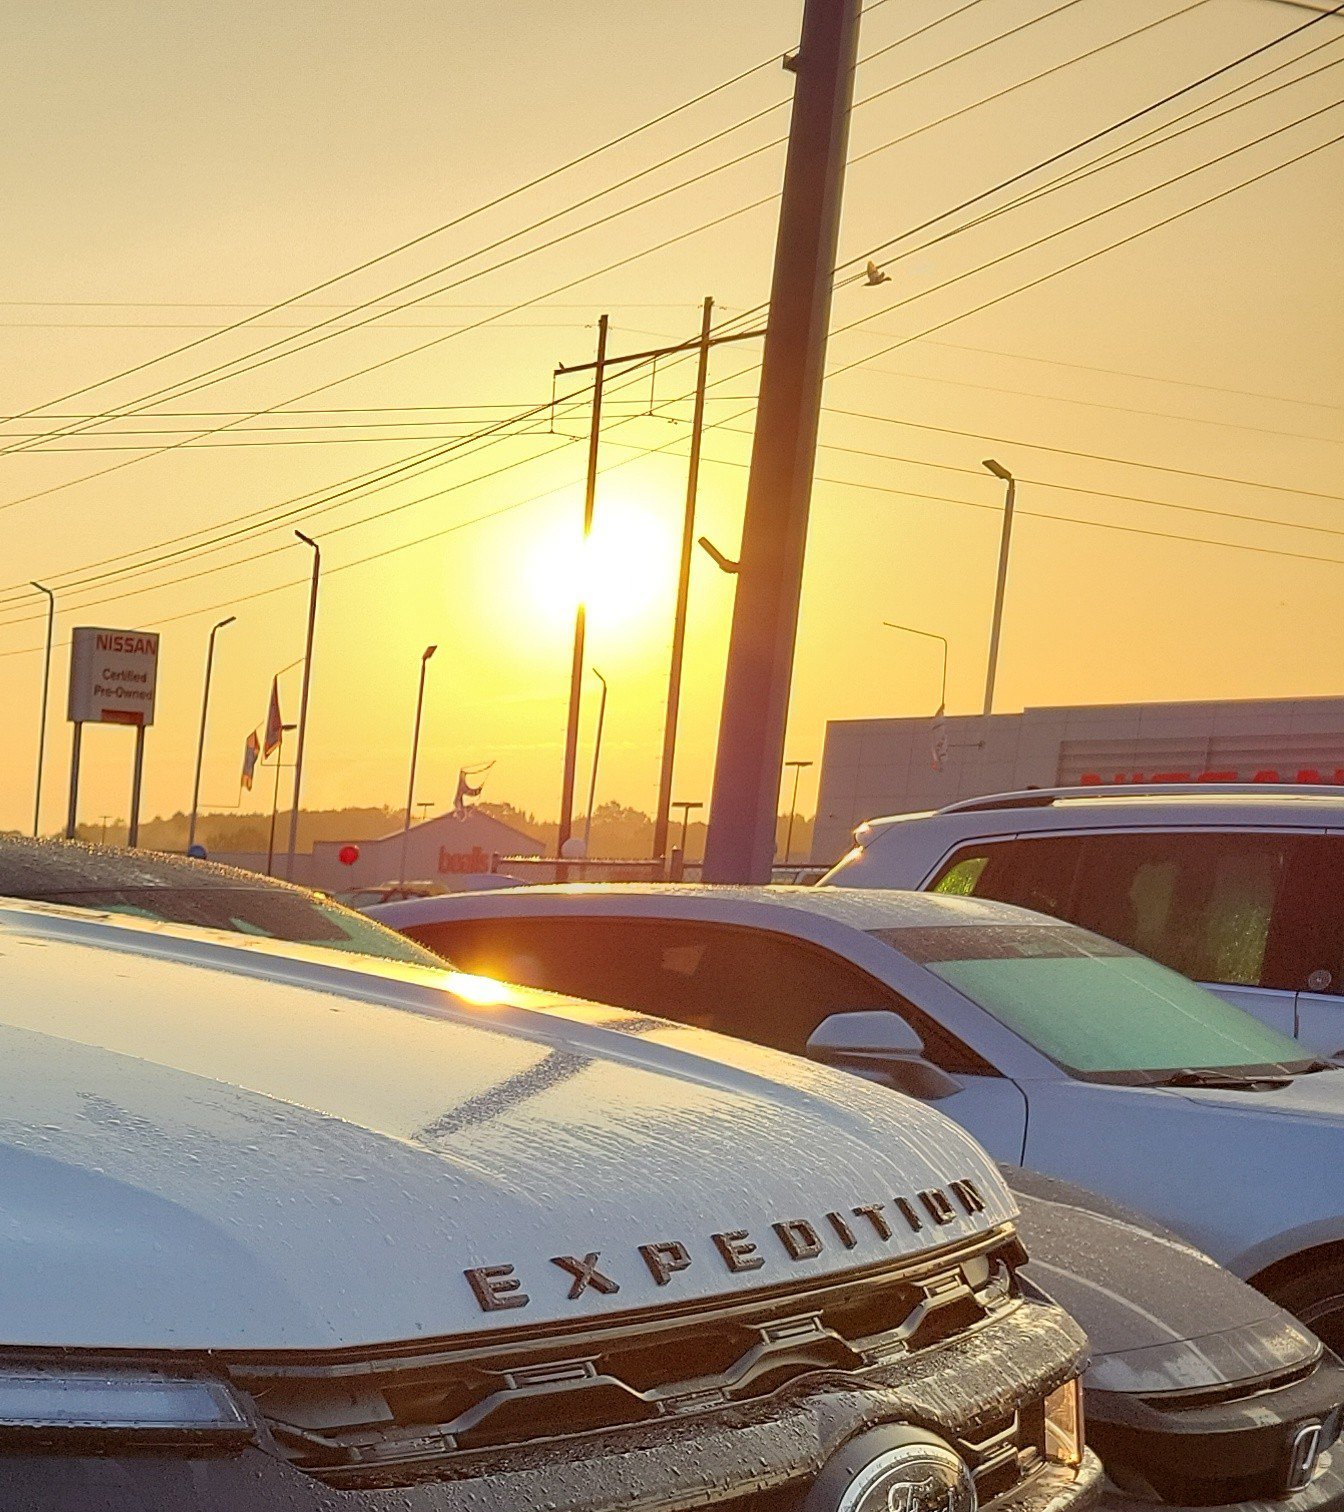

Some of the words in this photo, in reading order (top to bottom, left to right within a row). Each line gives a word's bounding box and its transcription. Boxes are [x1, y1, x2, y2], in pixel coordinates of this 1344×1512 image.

[96, 634, 156, 655] NISSAN
[102, 668, 147, 683] Certified
[94, 684, 153, 700] Pre-Owned
[463, 1179, 986, 1312] EXPEDITION
